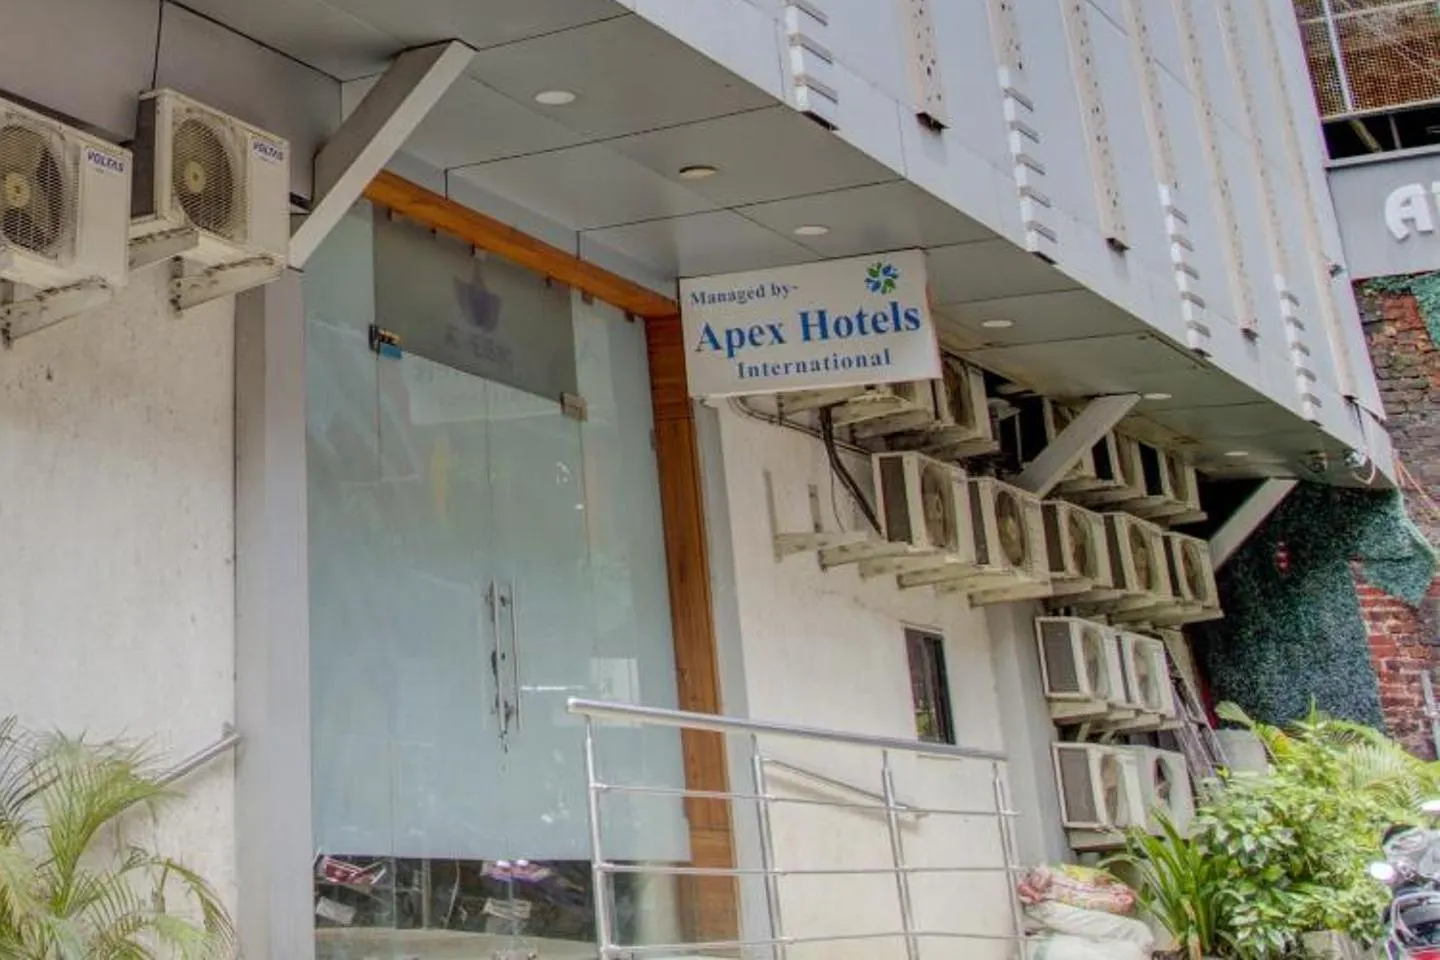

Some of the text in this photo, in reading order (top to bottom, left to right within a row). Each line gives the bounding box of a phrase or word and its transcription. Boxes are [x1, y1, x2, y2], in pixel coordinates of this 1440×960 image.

[689, 284, 765, 306] Managed
[695, 301, 921, 358] Apex Hotels
[737, 348, 892, 379] International
